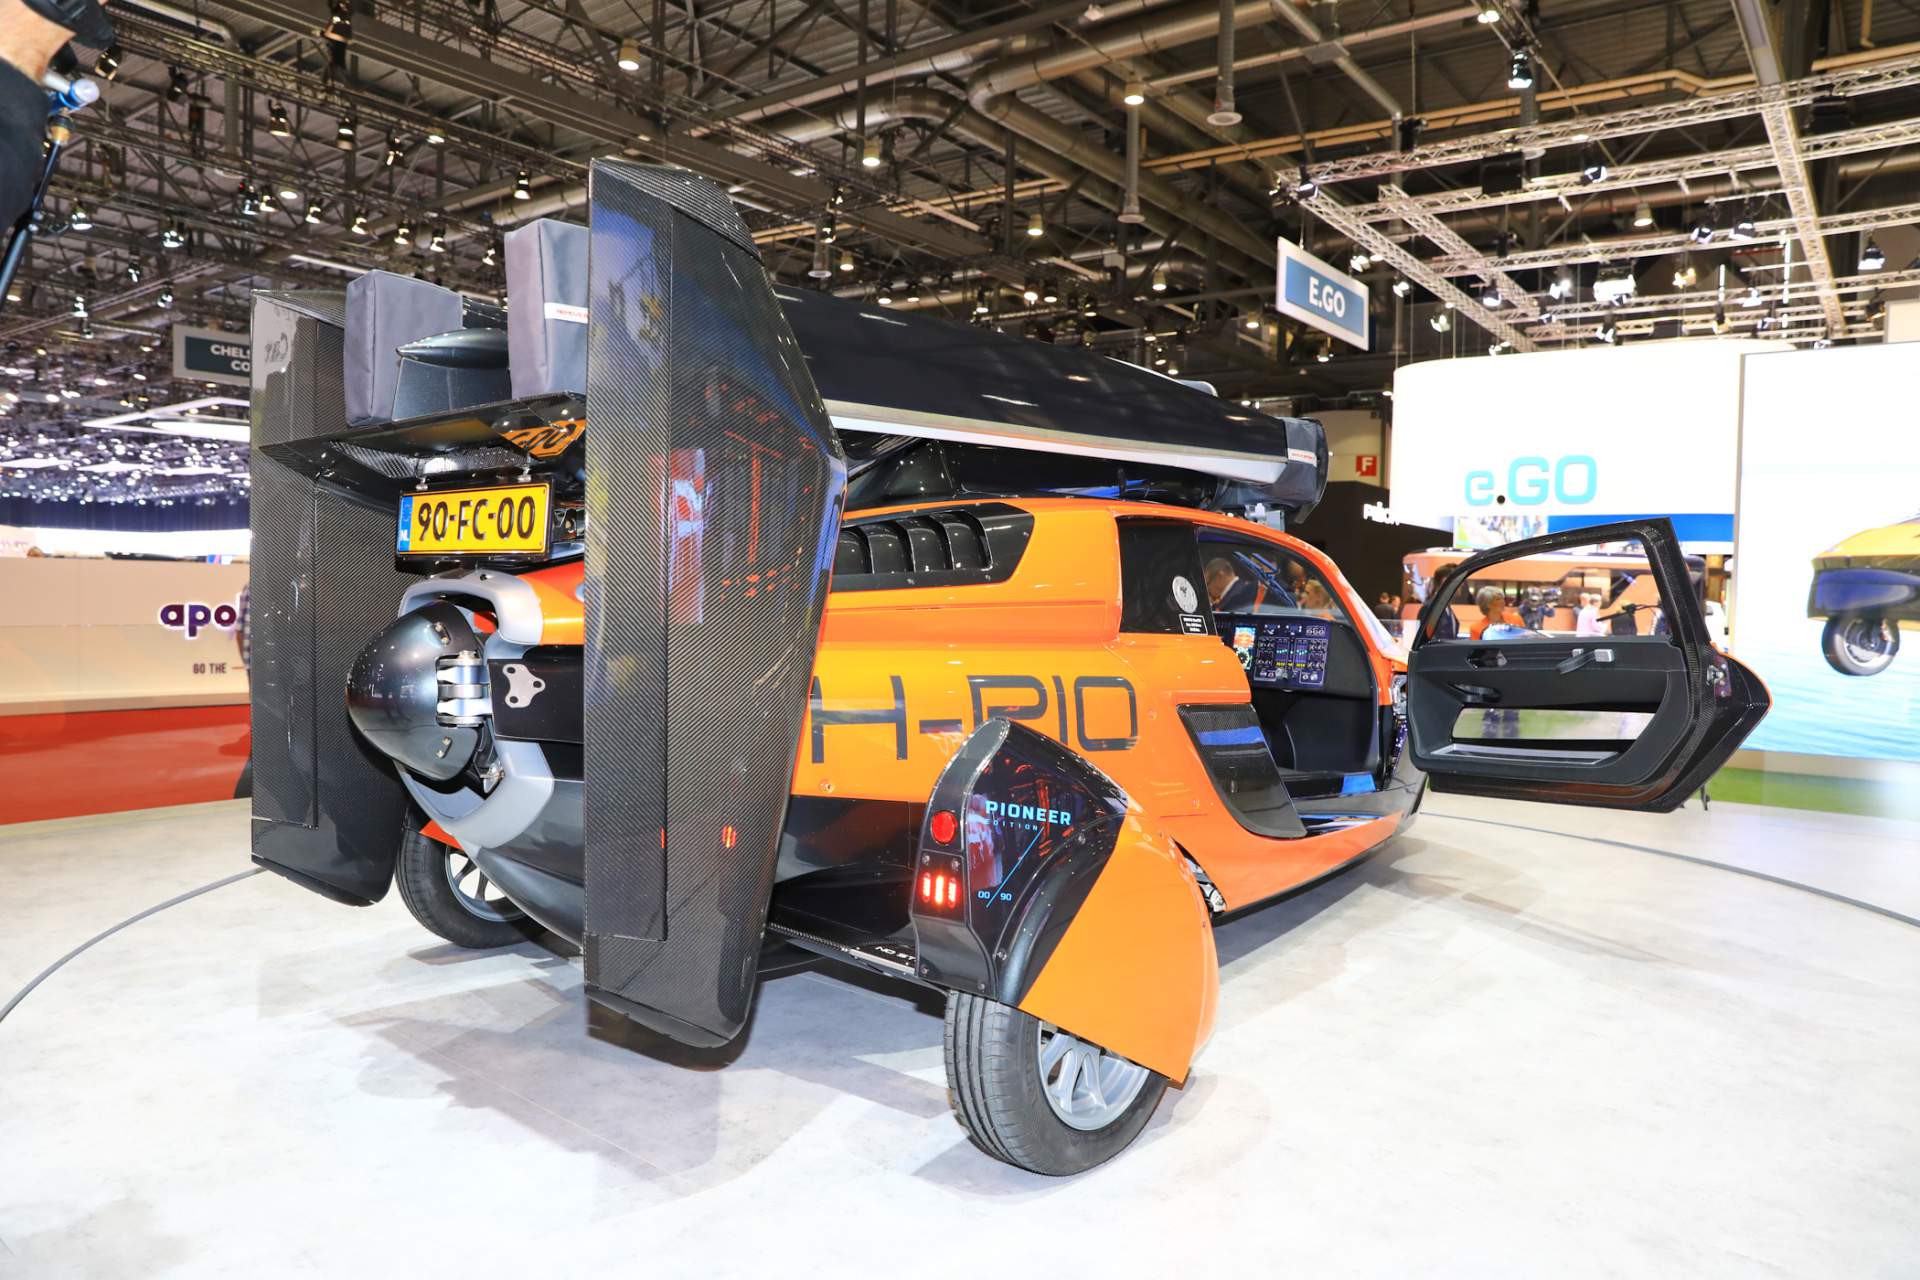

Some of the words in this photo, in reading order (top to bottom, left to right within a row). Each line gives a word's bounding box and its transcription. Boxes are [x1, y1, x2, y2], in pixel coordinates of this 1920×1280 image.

[1309, 276, 1346, 318] E.GO
[1464, 454, 1597, 506] e.GO
[418, 496, 536, 542] 90-FC-00
[159, 603, 238, 638] apo
[209, 662, 227, 674] THE
[985, 800, 1072, 826] PIONEER
[985, 818, 1038, 831] EDITION
